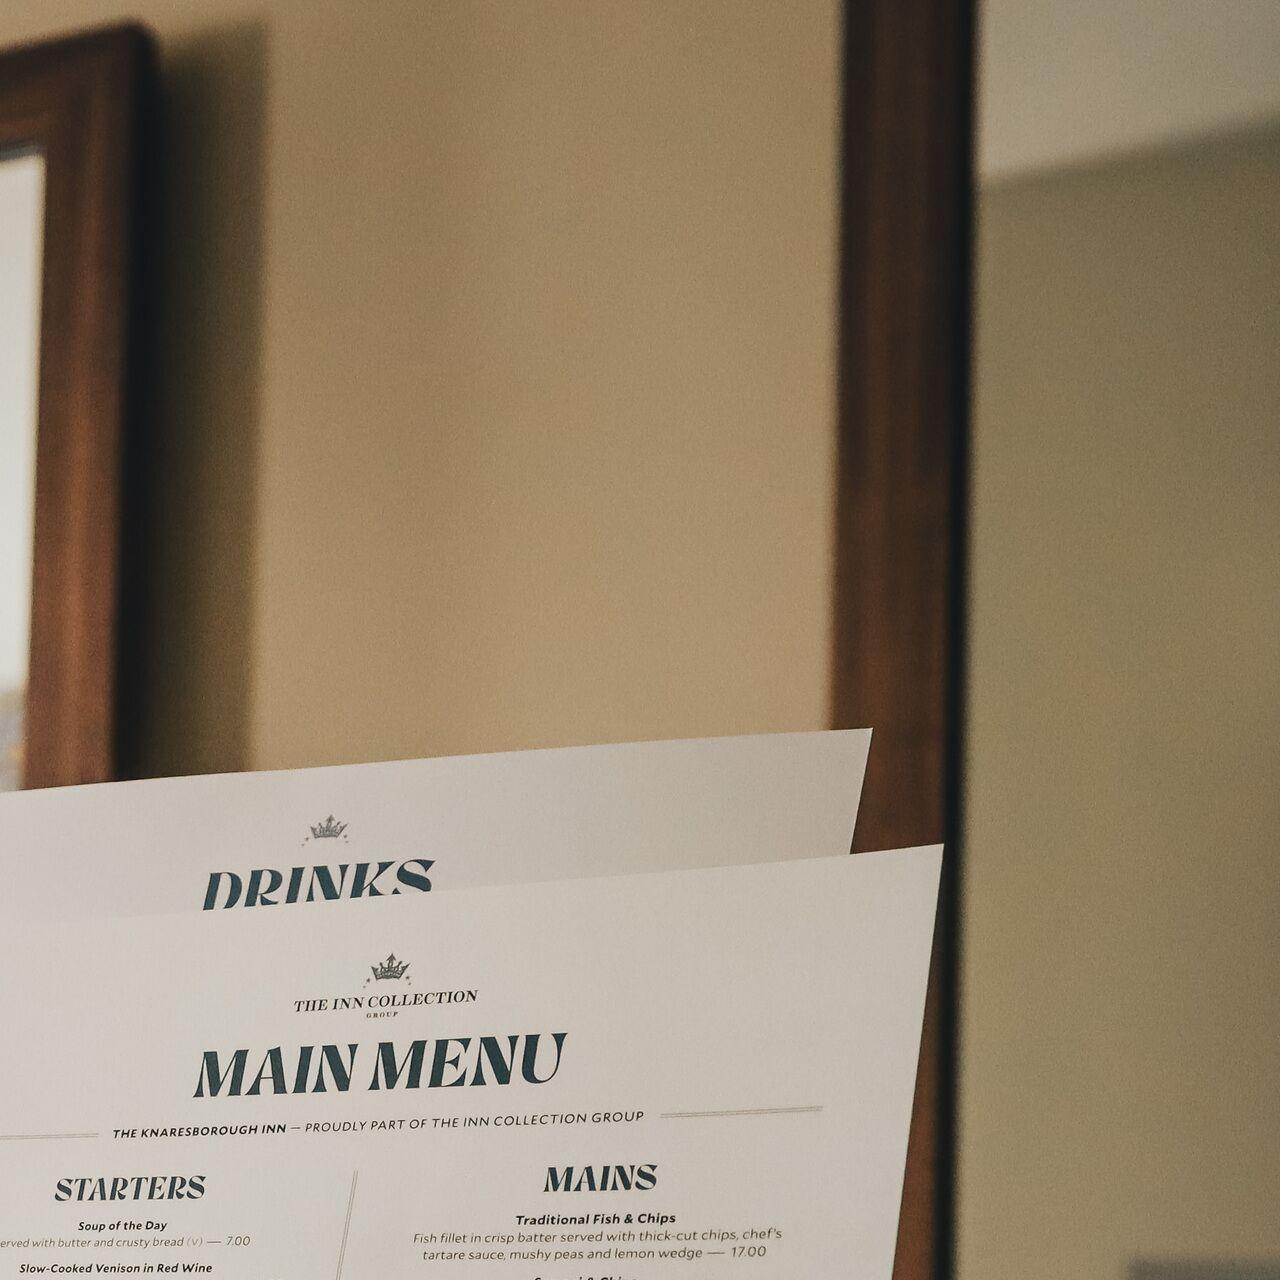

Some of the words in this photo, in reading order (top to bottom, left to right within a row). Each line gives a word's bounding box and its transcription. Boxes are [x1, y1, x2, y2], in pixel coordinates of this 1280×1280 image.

[202, 859, 438, 911] DRINKS
[294, 999, 328, 1013] THE
[333, 996, 365, 1011] INN
[368, 989, 479, 1008] COLLECTION
[365, 1011, 399, 1019] GROUP
[192, 1043, 359, 1098] MAIN
[367, 1033, 568, 1091] MENU
[112, 1128, 137, 1139] THE
[141, 1124, 258, 1138] KNARESBOROUGH
[261, 1123, 287, 1134] INN
[305, 1120, 367, 1133] PROUDLY
[370, 1119, 406, 1131] PART
[409, 1118, 428, 1130] OF
[432, 1117, 459, 1128] THE
[463, 1116, 490, 1127] INN
[493, 1113, 588, 1127] COLLECTION
[591, 1111, 644, 1123] GROUP
[543, 1164, 658, 1192] MAINS
[54, 1175, 207, 1202] STARTERS
[78, 1221, 106, 1233] Soup
[108, 1220, 122, 1231] of
[123, 1220, 142, 1231] the
[145, 1220, 168, 1233] Day
[515, 1214, 590, 1226] Traditional
[593, 1213, 620, 1225] Fish
[624, 1213, 634, 1225] &
[637, 1212, 676, 1226] Chips
[32, 1237, 55, 1248] with
[57, 1237, 91, 1248] butter
[93, 1236, 113, 1247] and
[115, 1237, 150, 1250] crusty
[152, 1236, 184, 1247] bread
[226, 1235, 251, 1247] 7.00
[413, 1233, 437, 1244] Fish
[440, 1232, 467, 1244] fillet
[470, 1233, 482, 1244] in
[484, 1233, 515, 1246] crisp
[517, 1231, 557, 1243] batter
[560, 1230, 603, 1242] served
[606, 1230, 636, 1242] with
[639, 1229, 698, 1242] thick-cut
[701, 1229, 740, 1243] chips,
[422, 1249, 465, 1260] tartare
[468, 1250, 507, 1262] sauce,
[509, 1248, 551, 1262] mushy
[554, 1250, 584, 1262] peas
[587, 1247, 612, 1259] and
[614, 1247, 655, 1259] lemon
[658, 1247, 703, 1261] wedge
[731, 1245, 767, 1258] 17.00
[19, 1263, 92, 1274] Slow-Cooked
[95, 1262, 140, 1274] Venison
[143, 1262, 154, 1273] in
[156, 1262, 178, 1273] Red
[181, 1262, 212, 1273] Wine
